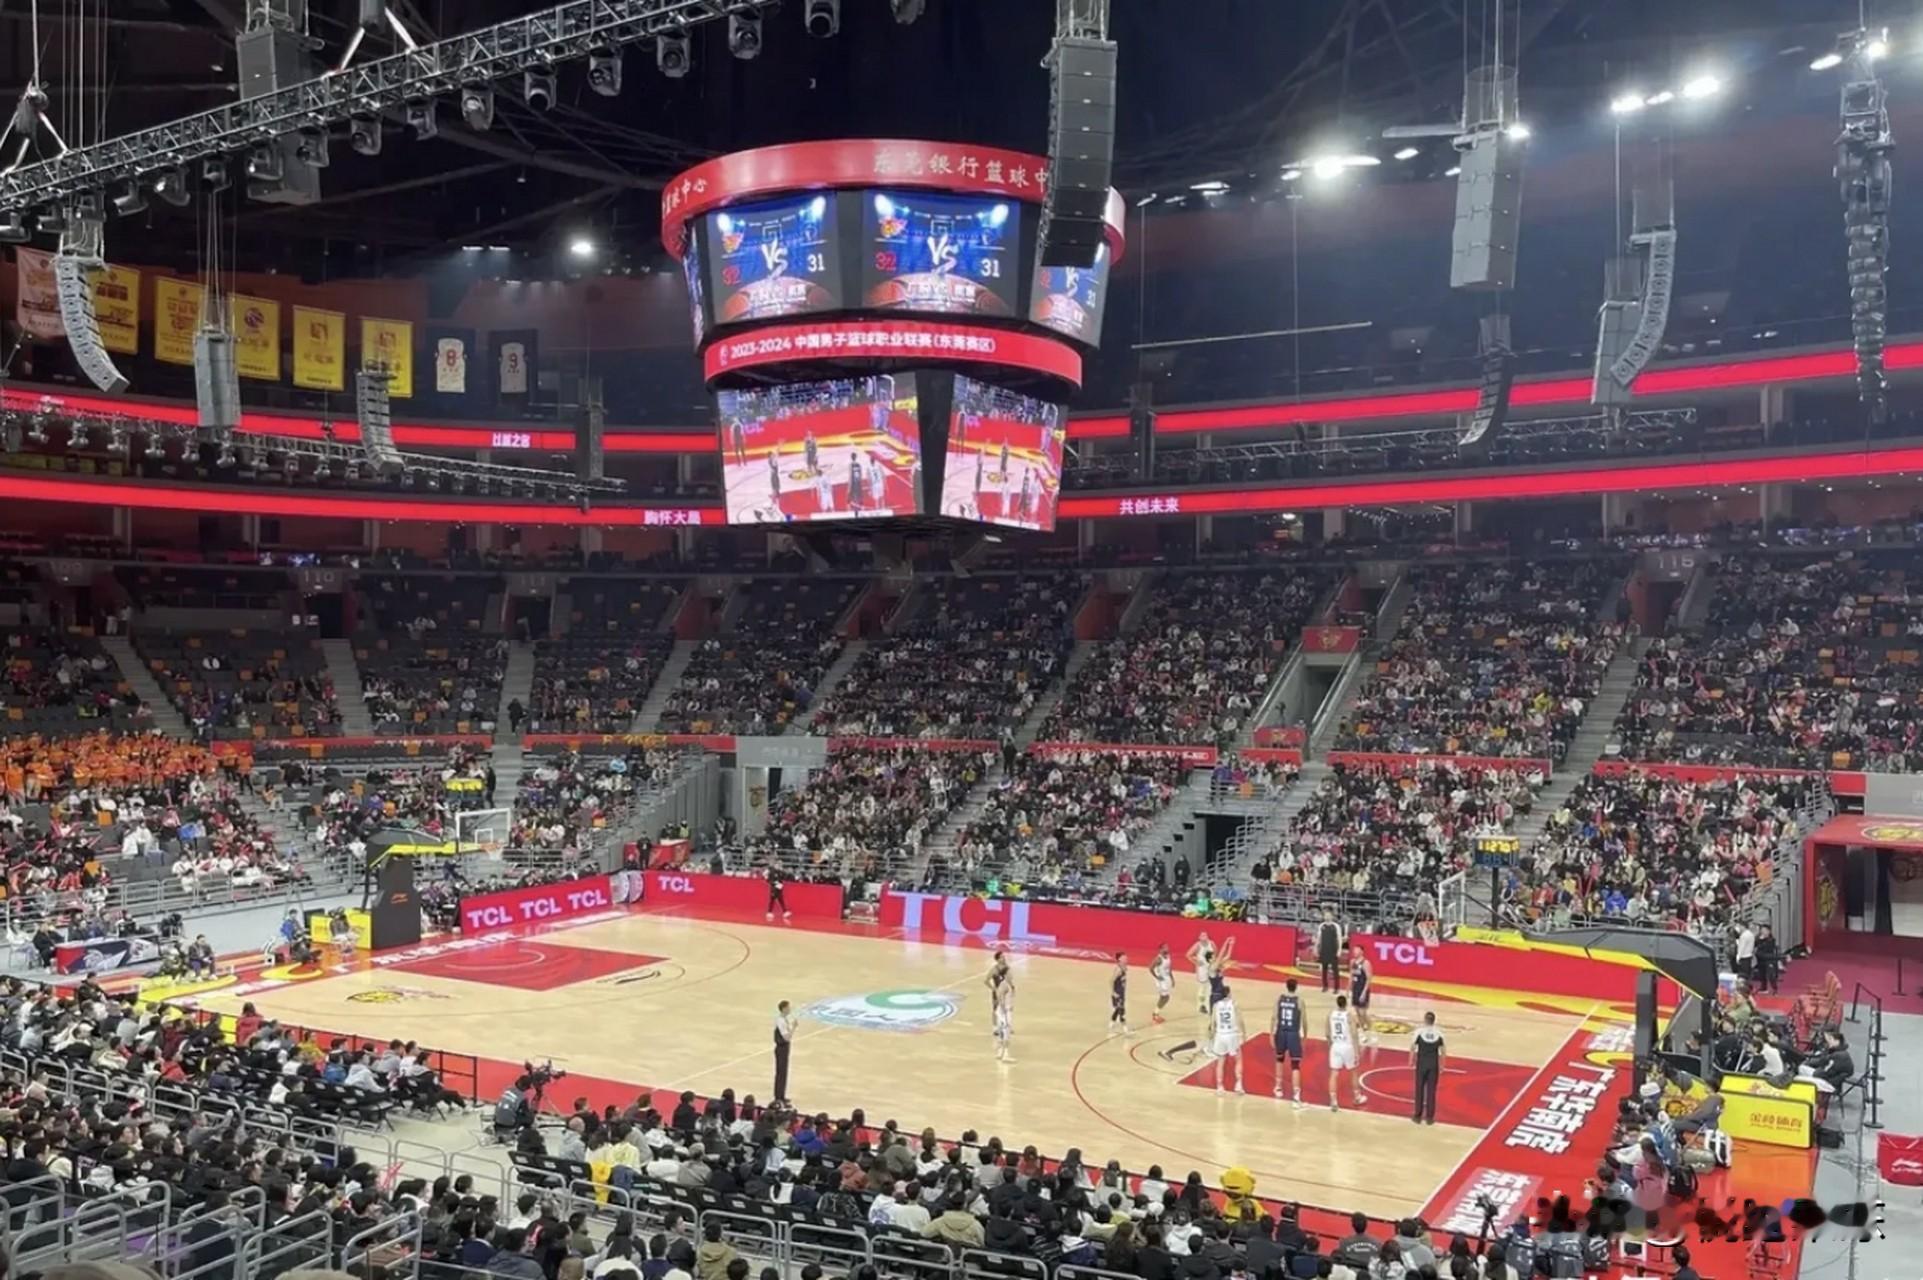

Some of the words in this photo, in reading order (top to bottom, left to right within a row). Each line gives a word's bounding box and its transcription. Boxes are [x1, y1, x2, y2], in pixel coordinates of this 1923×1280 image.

[808, 252, 826, 273] 31
[981, 258, 1001, 279] 31
[446, 349, 457, 367] 8
[730, 336, 793, 360] 2023-2024
[658, 875, 694, 893] TCL
[467, 907, 512, 928] TCL
[520, 897, 562, 918] TCL
[568, 889, 607, 910] TCL
[887, 890, 1056, 942] TCL
[1374, 941, 1434, 966] TCL
